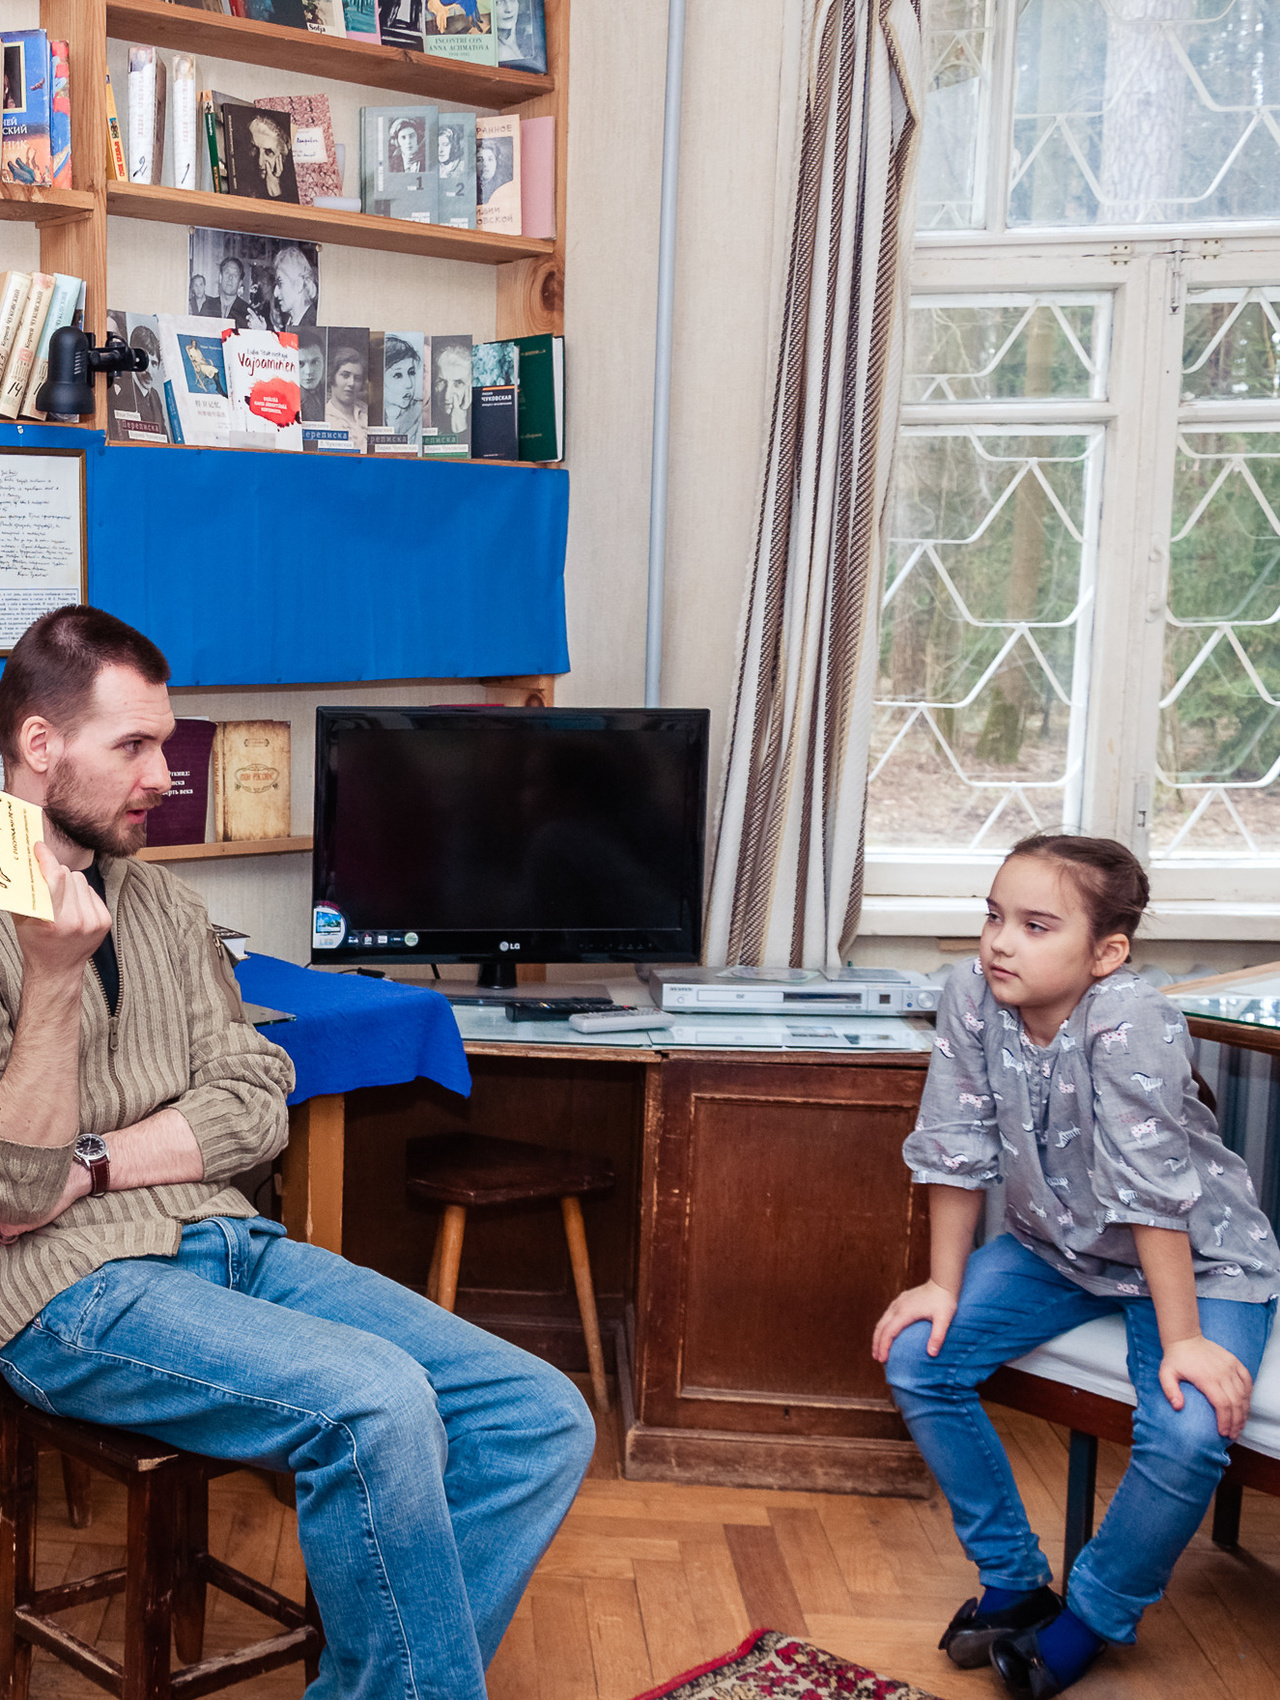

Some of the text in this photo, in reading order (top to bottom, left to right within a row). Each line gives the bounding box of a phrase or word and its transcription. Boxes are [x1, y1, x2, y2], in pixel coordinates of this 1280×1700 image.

[429, 44, 447, 52] ANNA
[133, 156, 148, 177] 2
[416, 176, 424, 190] 1
[455, 182, 465, 196] 2
[238, 352, 296, 376] Vajoaminen
[7, 381, 22, 397] 14
[122, 420, 159, 432] Переписка
[304, 429, 348, 440] ереписка
